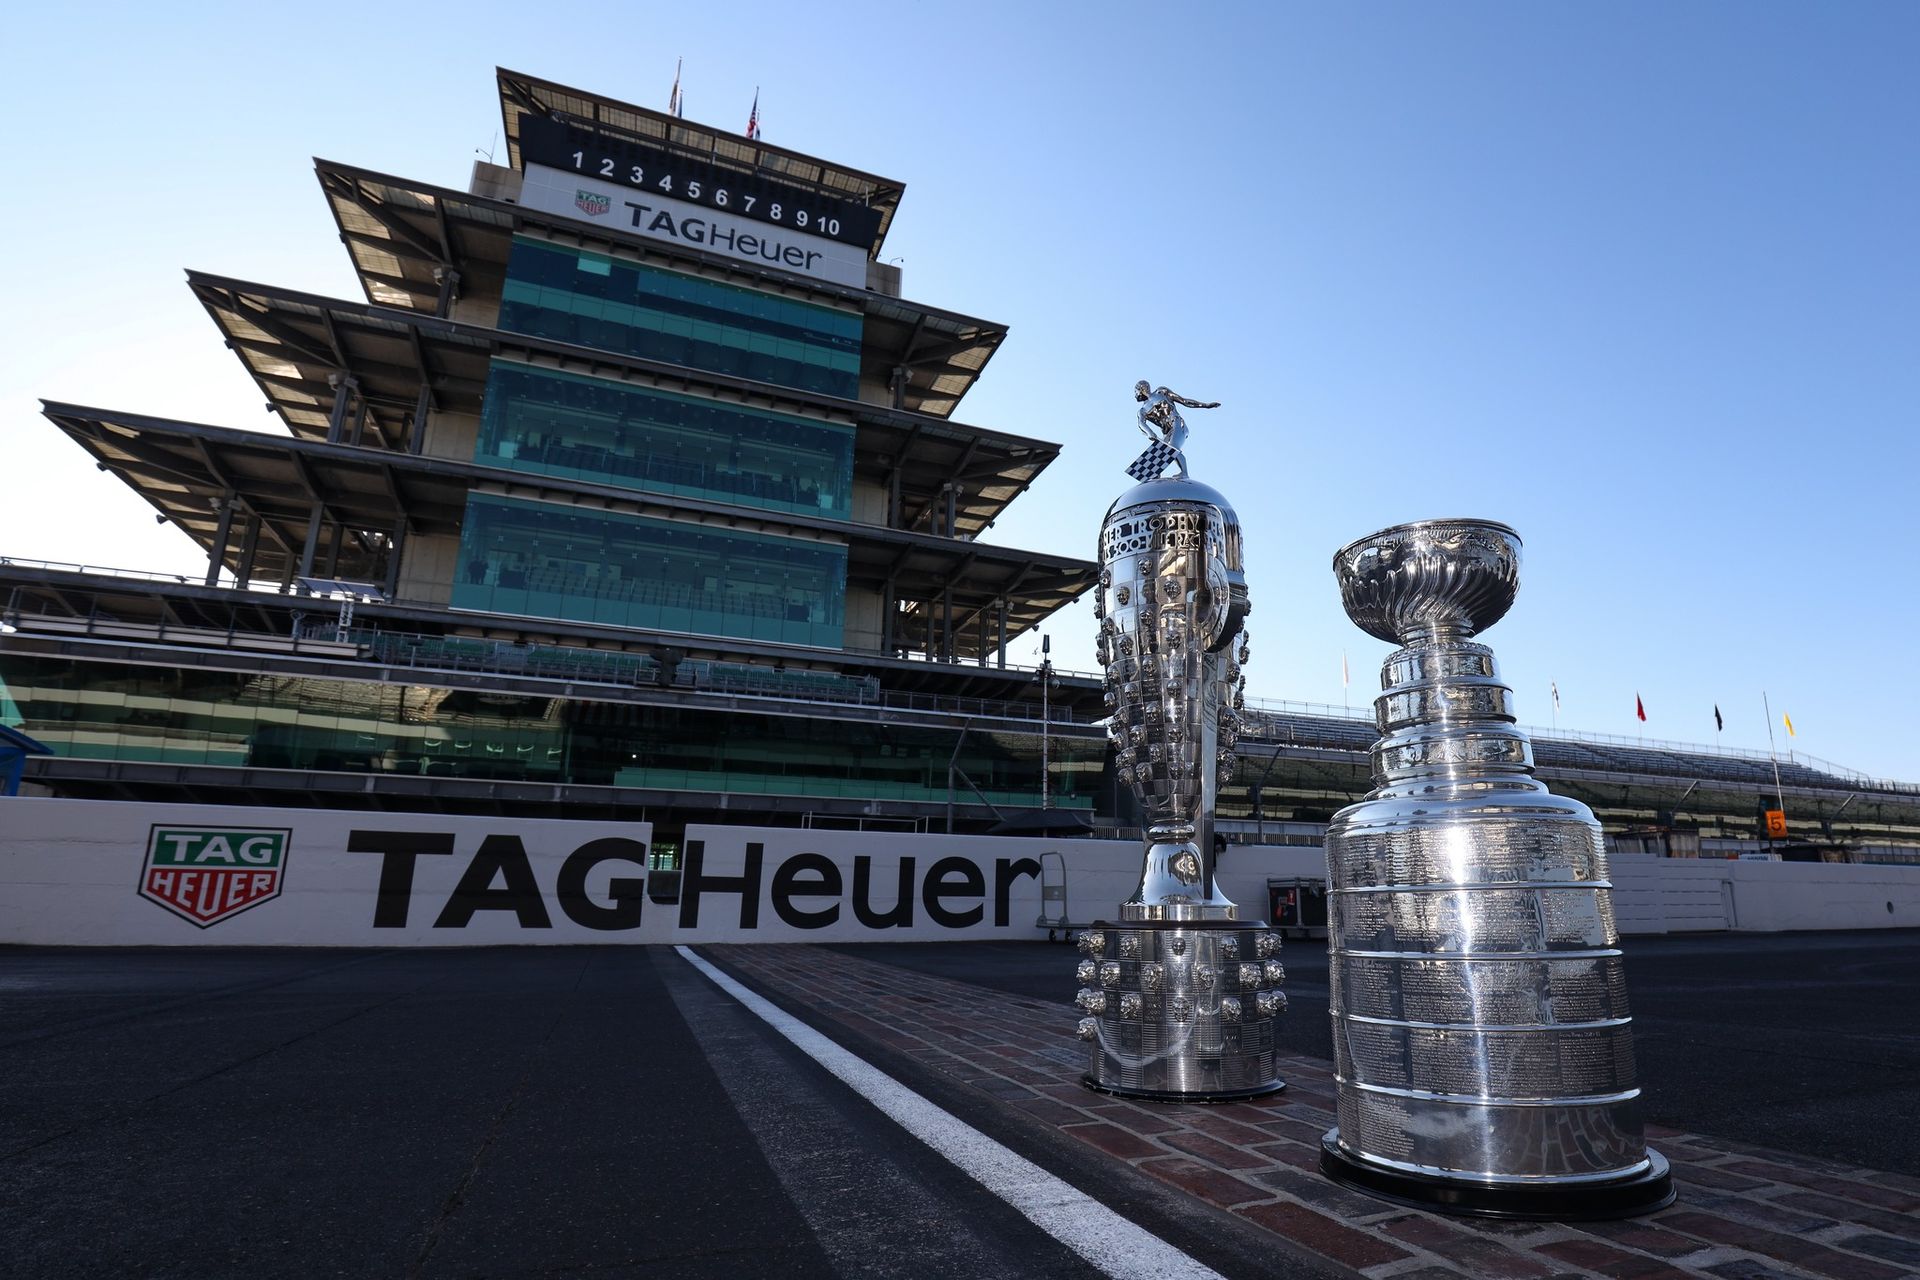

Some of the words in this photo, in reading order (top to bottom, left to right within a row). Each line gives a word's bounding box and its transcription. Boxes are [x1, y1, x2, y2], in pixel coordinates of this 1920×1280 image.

[573, 151, 584, 169] 1
[600, 158, 614, 177] 2
[630, 165, 644, 184] 3
[658, 174, 673, 192] 4
[687, 181, 701, 199] 5
[715, 188, 729, 206] 6
[744, 195, 757, 213] 7
[769, 203, 783, 221] 8
[796, 210, 808, 227] 9
[817, 216, 840, 236] 10
[579, 192, 608, 204] TAG
[1771, 816, 1782, 831] 5
[163, 833, 274, 864] TAG
[151, 870, 273, 917] HEUER
